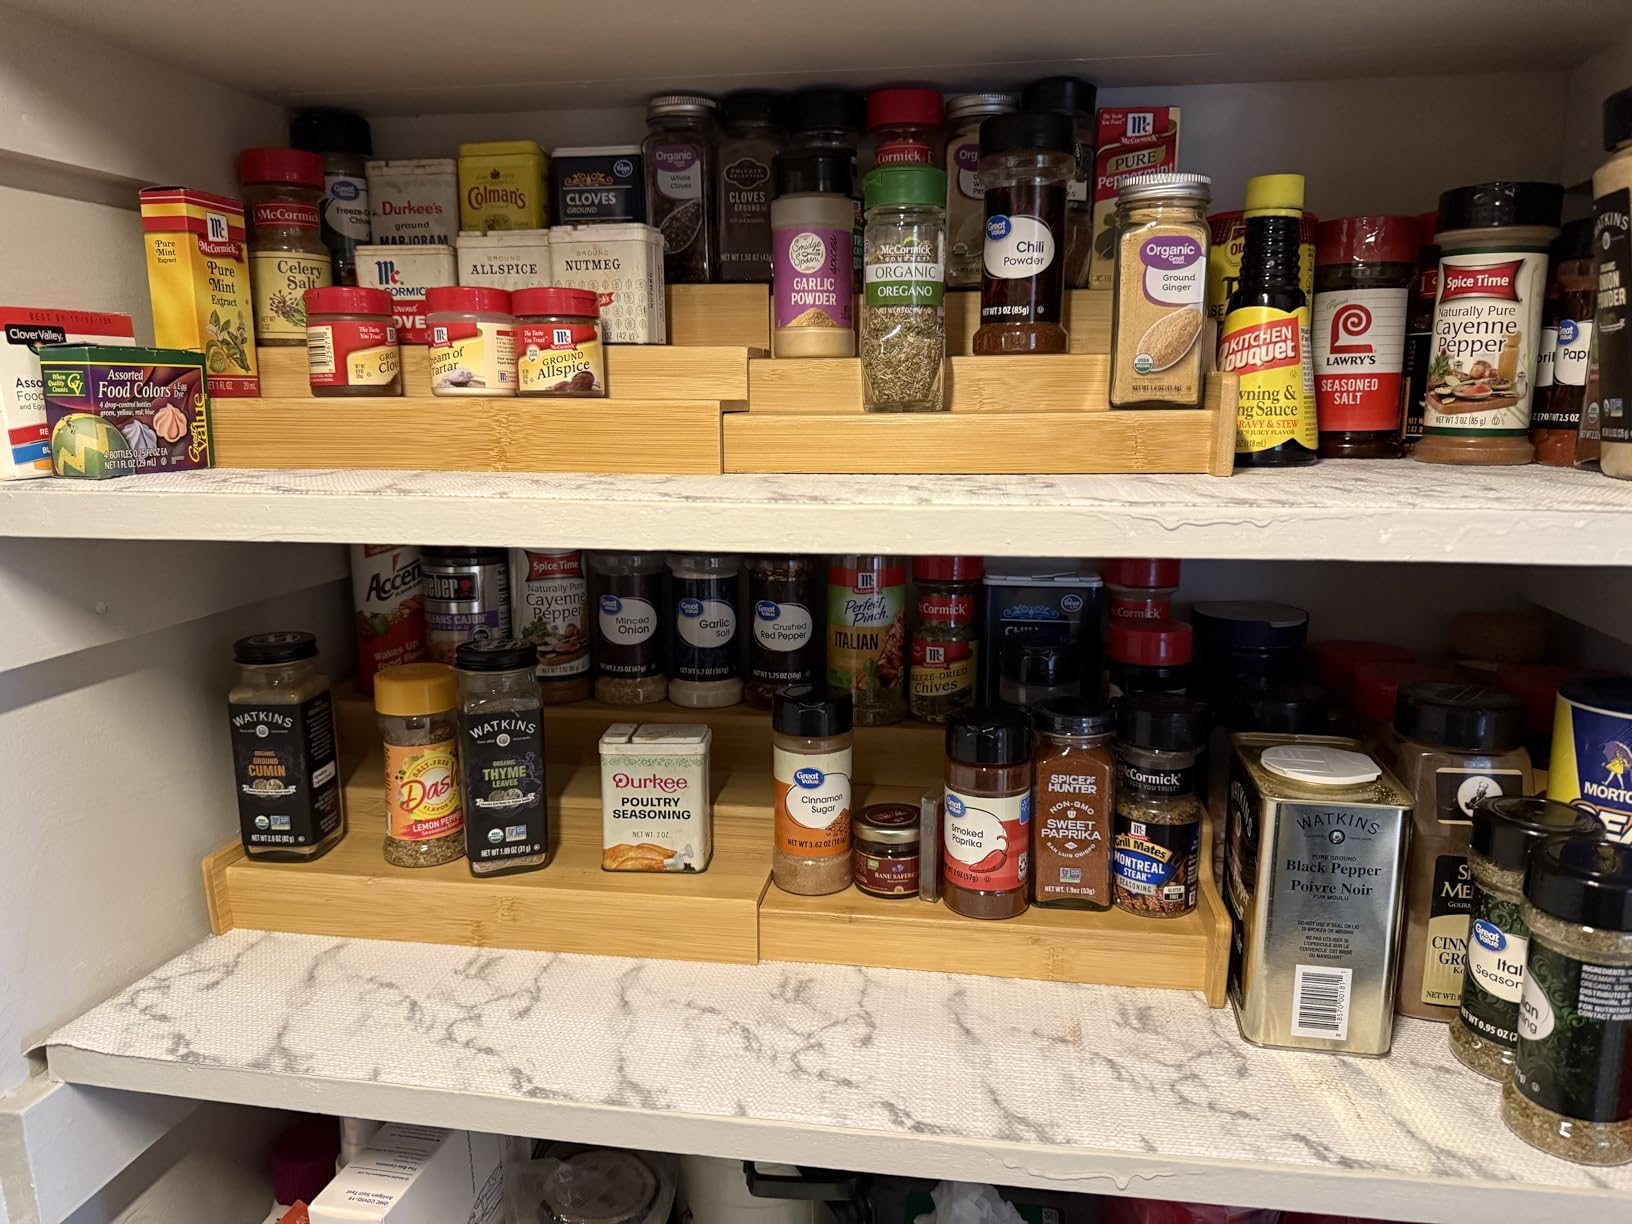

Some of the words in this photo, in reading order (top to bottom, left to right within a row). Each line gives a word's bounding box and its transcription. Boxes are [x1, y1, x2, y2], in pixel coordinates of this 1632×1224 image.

[1121, 134, 1157, 145] McCormick
[656, 151, 692, 163] Organic
[1115, 151, 1157, 170] PURE
[467, 186, 527, 210] Colman's
[566, 192, 617, 206] CLOVES
[729, 191, 766, 203] CLOVES
[382, 201, 443, 217] Durkee's
[566, 206, 598, 214] GROUND
[734, 203, 760, 212] GROUND
[394, 222, 429, 230] ground
[987, 220, 1007, 231] Great
[155, 240, 176, 248] Pure
[198, 240, 238, 254] McCormick
[880, 245, 931, 255] McCormick
[1016, 241, 1045, 253] Chili
[156, 248, 176, 257] Mint
[1146, 243, 1196, 258] Organic
[564, 258, 622, 272] NUTMEG
[1003, 256, 1045, 266] Powder
[206, 261, 236, 278] Pure
[277, 261, 322, 279] Celery
[470, 264, 538, 275] ALLSPICE
[875, 266, 936, 279] ORGANIC
[287, 275, 316, 291] Salt
[793, 277, 835, 291] GARLIC
[1162, 274, 1196, 282] Ground
[1447, 276, 1475, 290] Spice
[1477, 274, 1509, 287] Time
[209, 279, 236, 294] Mint
[877, 286, 933, 297] OREGANO
[1162, 284, 1192, 293] Ginger
[211, 295, 238, 308] Extract
[791, 292, 837, 305] POWDER
[1003, 306, 1011, 314] OZ
[1438, 305, 1484, 319] Naturally
[1487, 305, 1516, 316] Pure
[1435, 319, 1518, 337] Cayenne
[1230, 325, 1292, 351] KITCHEN
[452, 346, 465, 358] of
[1438, 336, 1507, 357] Pepper
[542, 351, 584, 366] GROUND
[1326, 355, 1376, 366] LAWRY'S
[107, 369, 144, 381] Assorted
[537, 361, 590, 380] Allspice
[98, 382, 130, 398] Food
[134, 382, 171, 398] Colors
[1321, 378, 1378, 392] SEASONED
[173, 389, 185, 398] Dye
[1284, 385, 1296, 400] &
[1333, 392, 1363, 405] SALT
[104, 401, 135, 410] drop-control
[1256, 401, 1298, 417] Sauce
[1435, 416, 1444, 424] NET
[1444, 416, 1454, 425] WT
[1459, 416, 1468, 424] OZ
[1570, 413, 1580, 421] OZ
[1276, 420, 1298, 428] STEW
[109, 449, 133, 459] BOTTLES
[104, 461, 116, 470] NET
[128, 460, 136, 469] OZ
[533, 561, 559, 573] Spice
[560, 560, 579, 570] Time
[527, 583, 567, 594] Naturally
[681, 602, 699, 611] Great
[757, 605, 775, 614] Great
[844, 596, 885, 616] Perfect
[454, 614, 485, 625] CAJUN
[615, 616, 650, 625] Minced
[699, 618, 730, 630] Garlic
[617, 625, 650, 635] Onion
[773, 622, 807, 631] Crushed
[716, 629, 731, 638] Salt
[760, 631, 777, 640] Red
[777, 631, 807, 641] Pepper
[834, 631, 879, 651] ITALIAN
[914, 679, 958, 695] Chives
[232, 711, 294, 729] WATKINS
[469, 719, 537, 739] WATKINS
[253, 757, 279, 765] GROUND
[248, 765, 286, 777] CUMIN
[412, 759, 449, 778] SALT-FREE
[483, 765, 527, 781] THYME
[796, 772, 819, 780] Great
[1050, 774, 1088, 785] SPICE
[492, 779, 519, 788] LEAVES
[612, 773, 689, 794] Durkee
[1048, 783, 1097, 794] HUNTER
[621, 797, 681, 808] POULTRY
[801, 794, 843, 805] Cinnamon
[423, 803, 449, 812] FLAVOR
[811, 804, 836, 816] Sugar
[1049, 800, 1095, 816] NON-GMO
[612, 809, 692, 820] SEASONING
[412, 821, 440, 833] LEMON
[1047, 819, 1096, 831] SWEET
[1296, 812, 1380, 835] WATKINS
[632, 831, 644, 839] NET
[656, 831, 661, 839] 2
[951, 823, 984, 839] Smoked
[1041, 828, 1102, 841] PAPRIKA
[787, 838, 798, 846] NET
[798, 839, 808, 848] WT
[809, 839, 823, 848] 3.62
[824, 839, 832, 848] OZ
[952, 833, 983, 848] Paprika
[481, 849, 490, 857] NET
[1046, 841, 1058, 854] SAN
[1058, 851, 1073, 859] LUIS
[1074, 843, 1096, 858] OBISPO
[1114, 836, 1131, 848] Grill
[1133, 840, 1167, 860] Mates
[1114, 849, 1165, 874] MONTREAL
[1123, 867, 1148, 881] STEAK
[1286, 859, 1326, 873] Black
[1331, 862, 1382, 879] Pepper
[874, 872, 892, 880] BANU
[1081, 887, 1096, 895] (53g)
[1119, 877, 1152, 893] SEASONING
[1290, 879, 1337, 894] Poivre
[1341, 883, 1374, 896] Noir
[1475, 923, 1500, 943] Great
[1479, 933, 1499, 948] Value
[1426, 990, 1441, 999] NET
[1580, 987, 1626, 999] DISTRIBUTED
[1578, 1002, 1593, 1010] FOR
[1594, 1005, 1630, 1014] NUTRITION
[1578, 1009, 1611, 1020] CONTACT
[1468, 1013, 1479, 1026] WT
[1478, 1017, 1496, 1035] 0.95
[1496, 1027, 1509, 1040] OZ
[348, 1196, 376, 1204] COVID-19
[371, 1192, 394, 1200] Antigen
